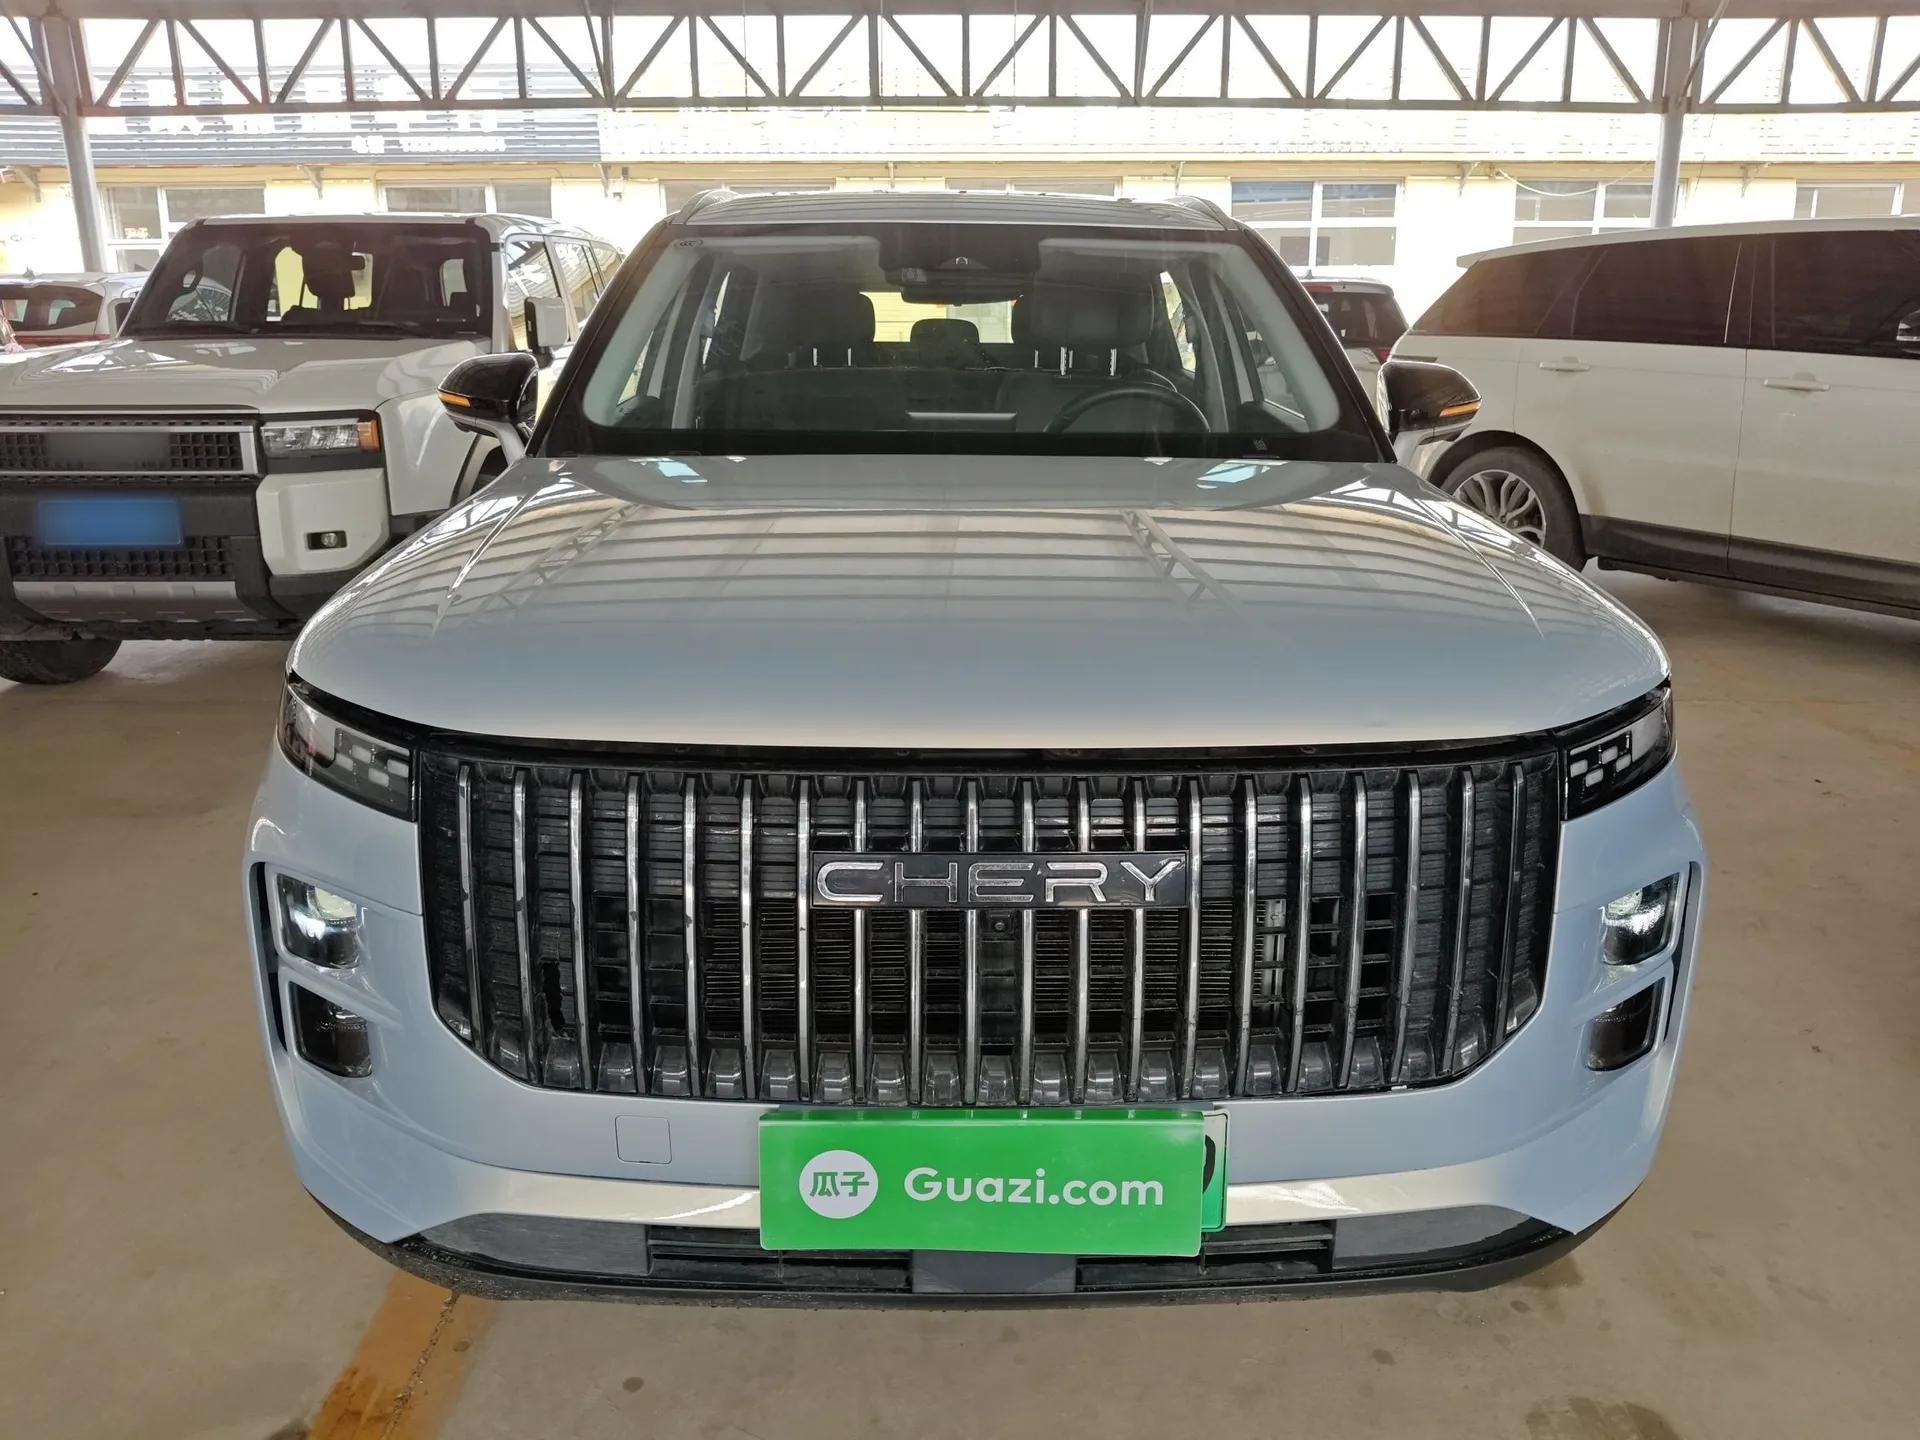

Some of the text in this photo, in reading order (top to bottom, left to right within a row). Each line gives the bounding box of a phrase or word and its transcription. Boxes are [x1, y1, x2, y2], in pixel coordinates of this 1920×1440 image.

[816, 861, 1181, 903] CHERY
[809, 1171, 870, 1198] 瓜子
[904, 1167, 1164, 1206] Guazi.com
